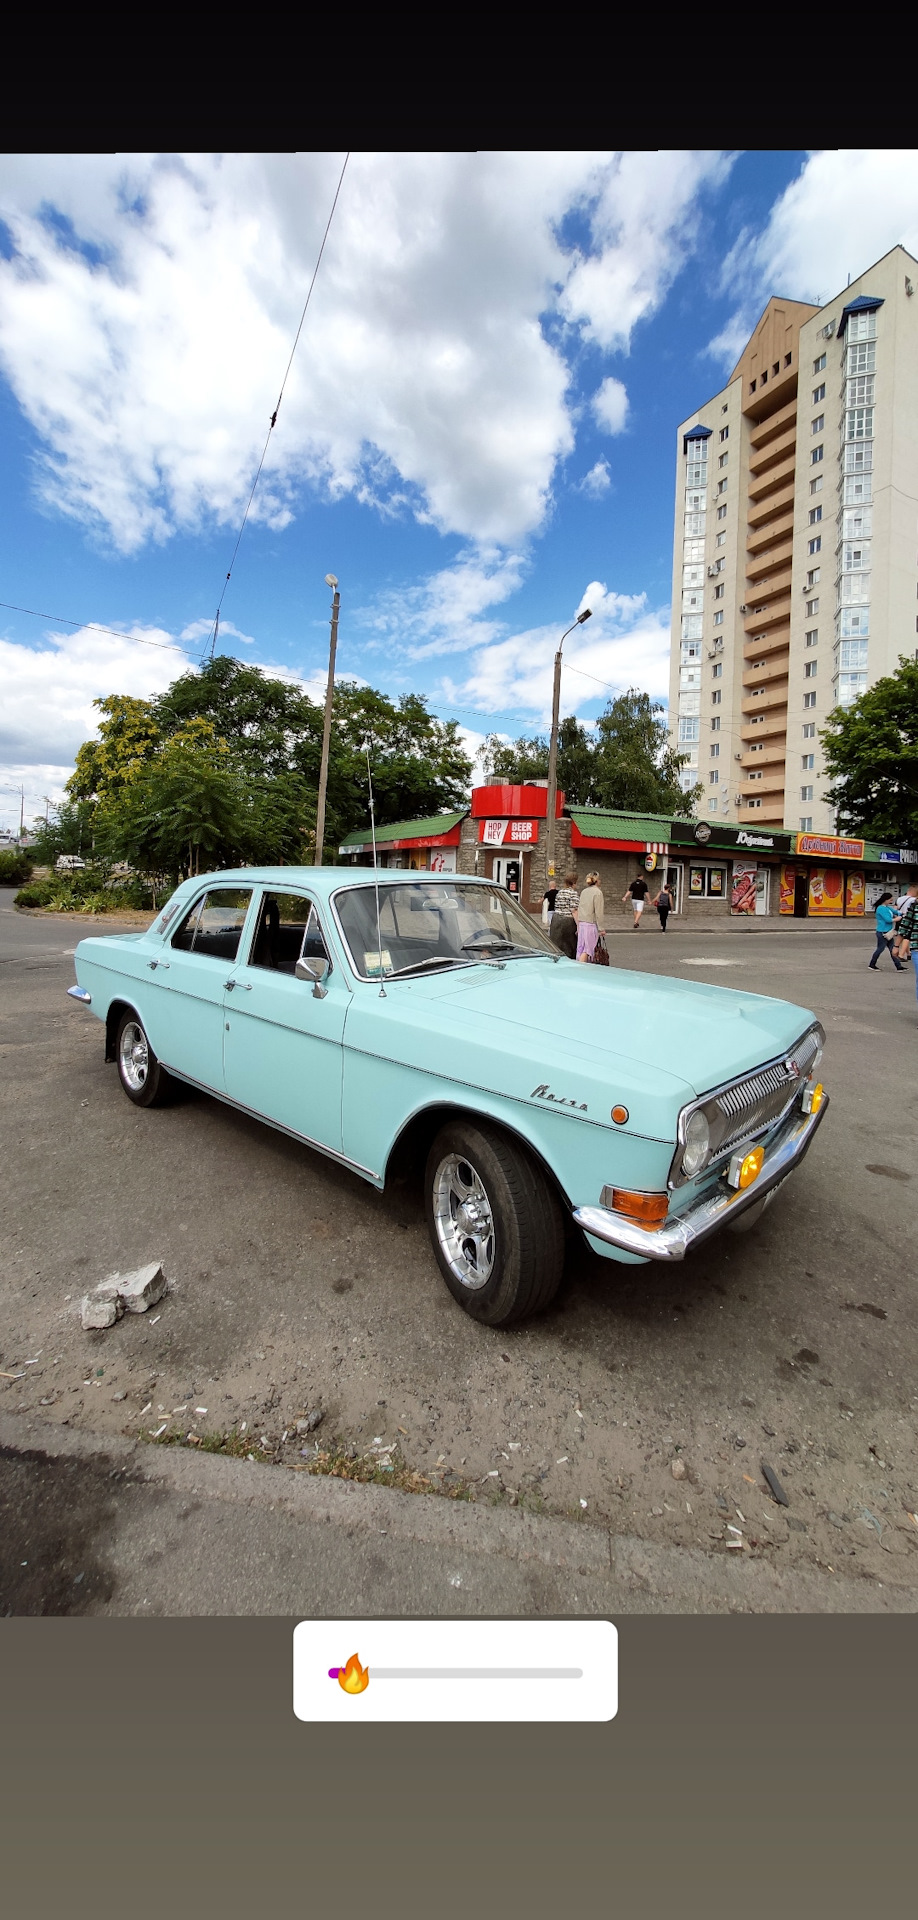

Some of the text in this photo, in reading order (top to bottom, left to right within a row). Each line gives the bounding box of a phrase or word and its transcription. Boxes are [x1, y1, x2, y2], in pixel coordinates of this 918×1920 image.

[488, 822, 502, 831] HOP
[511, 822, 533, 831] BEER
[487, 831, 501, 839] HEY
[511, 831, 532, 840] SHOP
